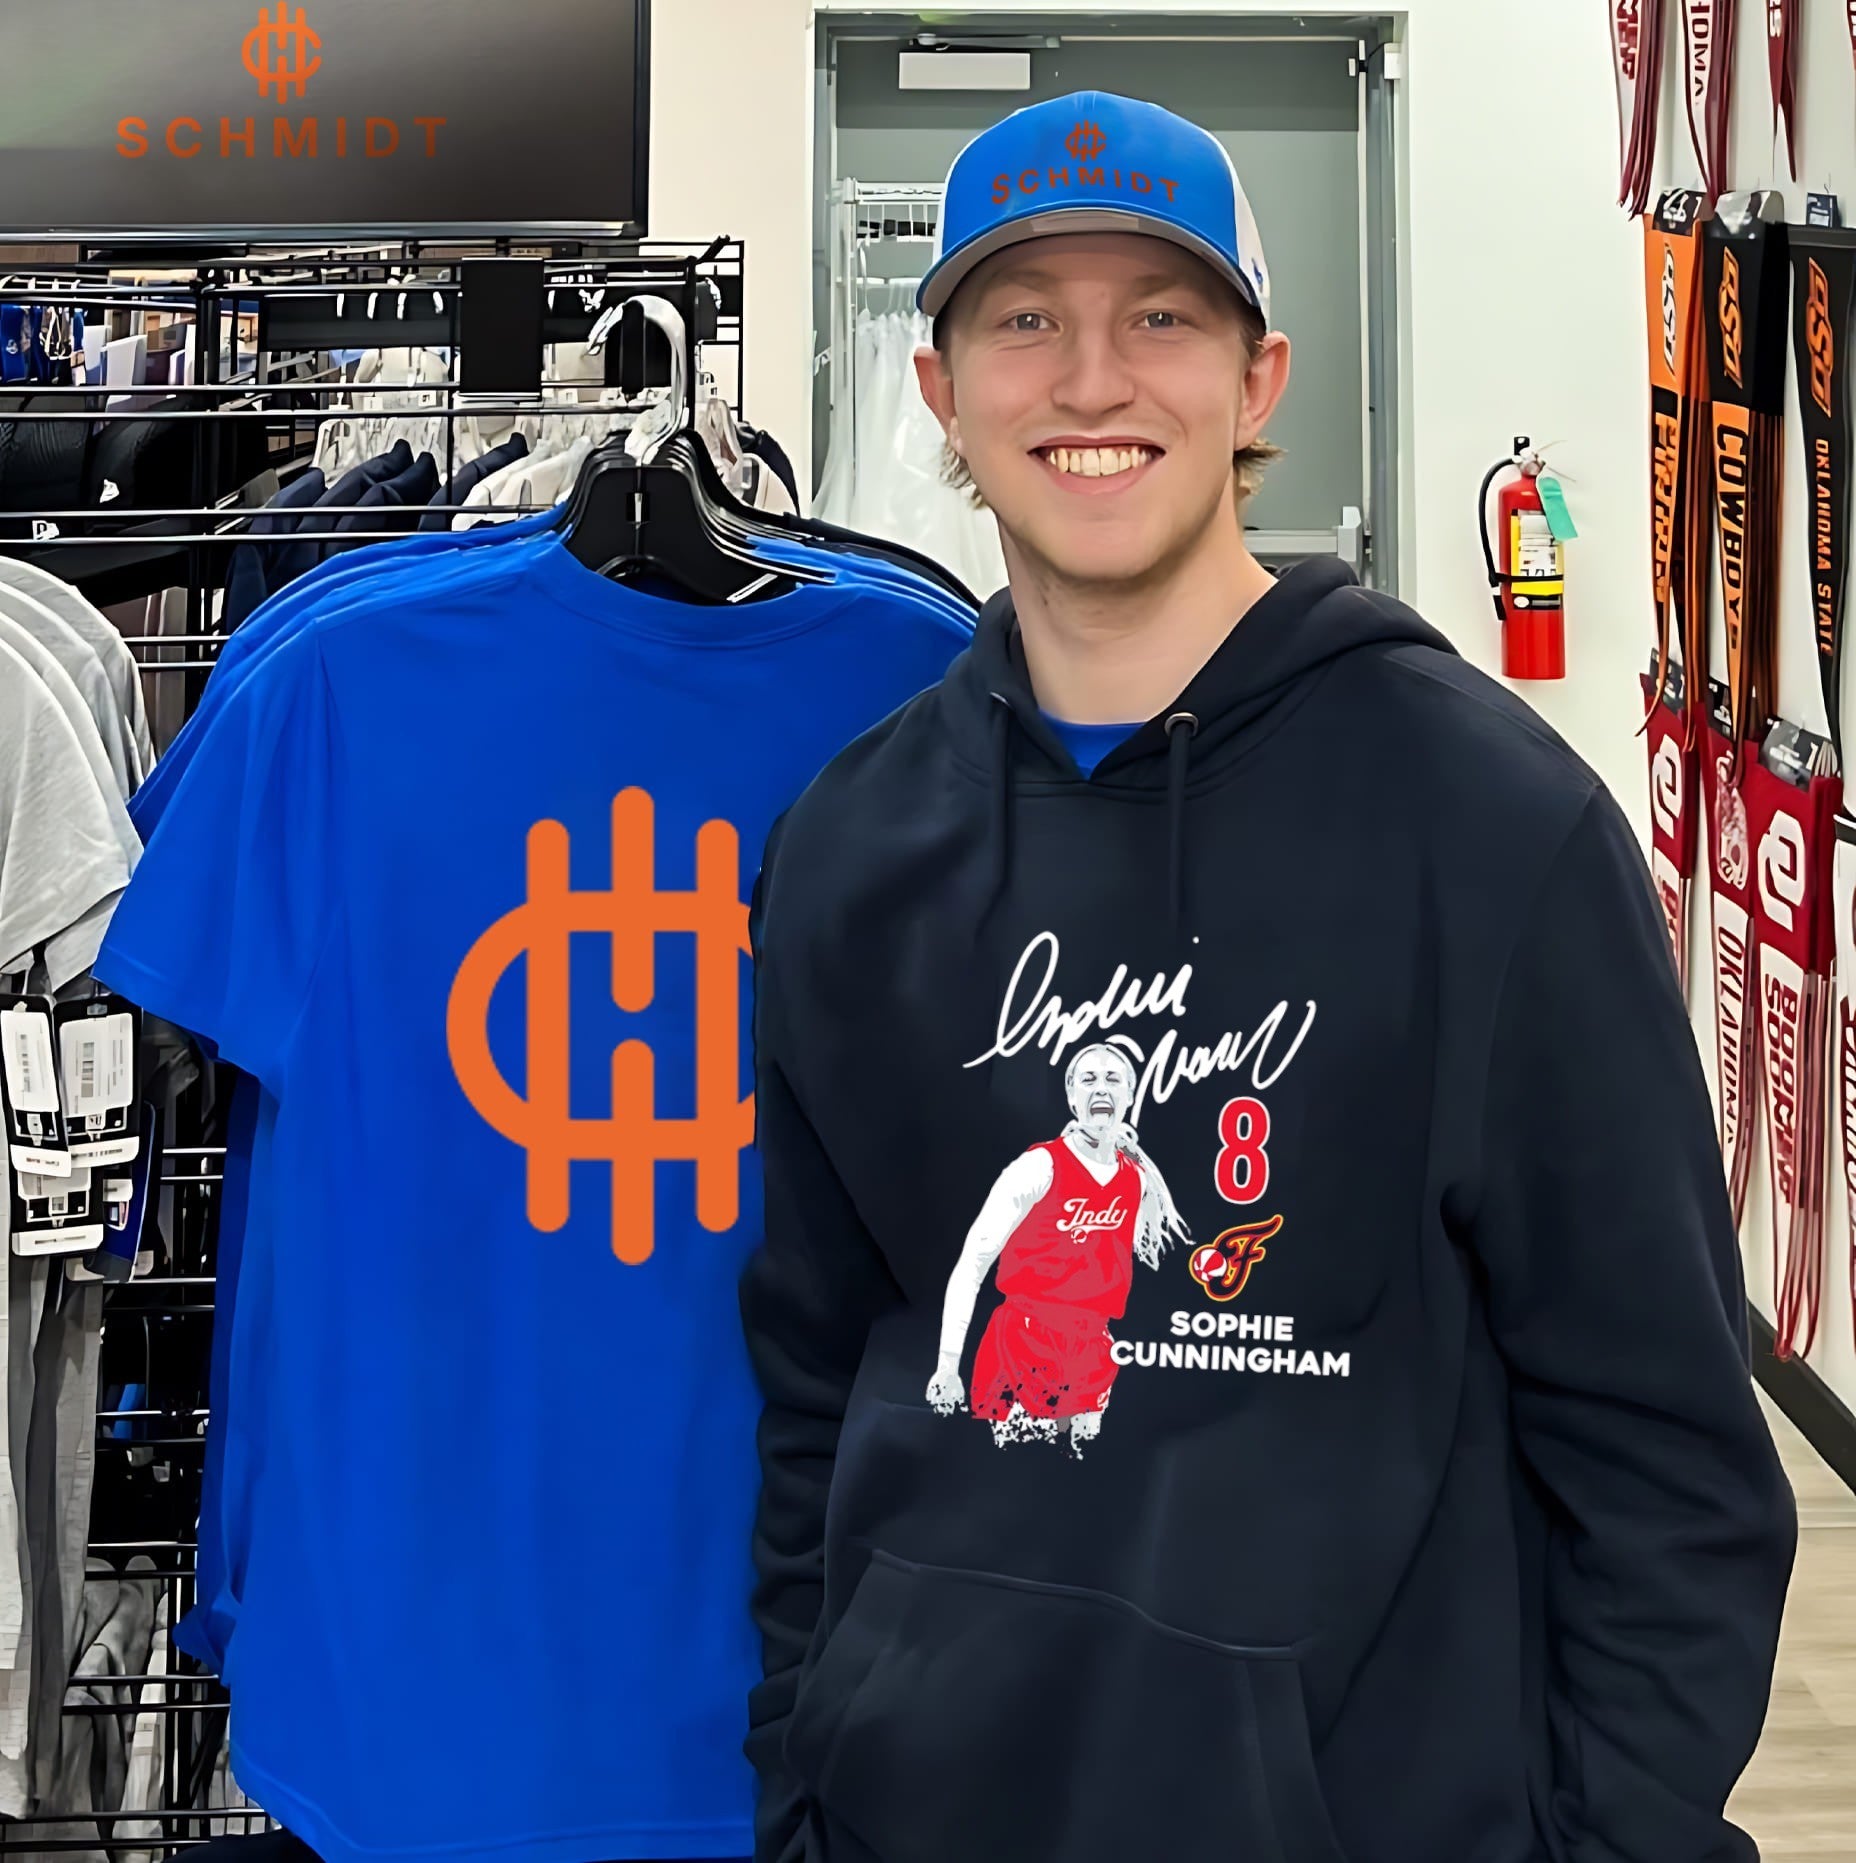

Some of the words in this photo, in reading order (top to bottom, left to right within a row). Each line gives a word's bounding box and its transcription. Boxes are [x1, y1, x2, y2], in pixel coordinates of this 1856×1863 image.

[115, 116, 448, 158] SCHMIDT
[991, 167, 1180, 204] SCHMIDT
[1815, 438, 1832, 571] OKLAHOMA
[1718, 925, 1746, 1144] OKLAHOMA
[1214, 1096, 1271, 1204] 8
[1056, 1197, 1127, 1234] Indy
[1169, 1310, 1294, 1341] SOPHIE
[1109, 1340, 1350, 1378] CUNNINGHAM
